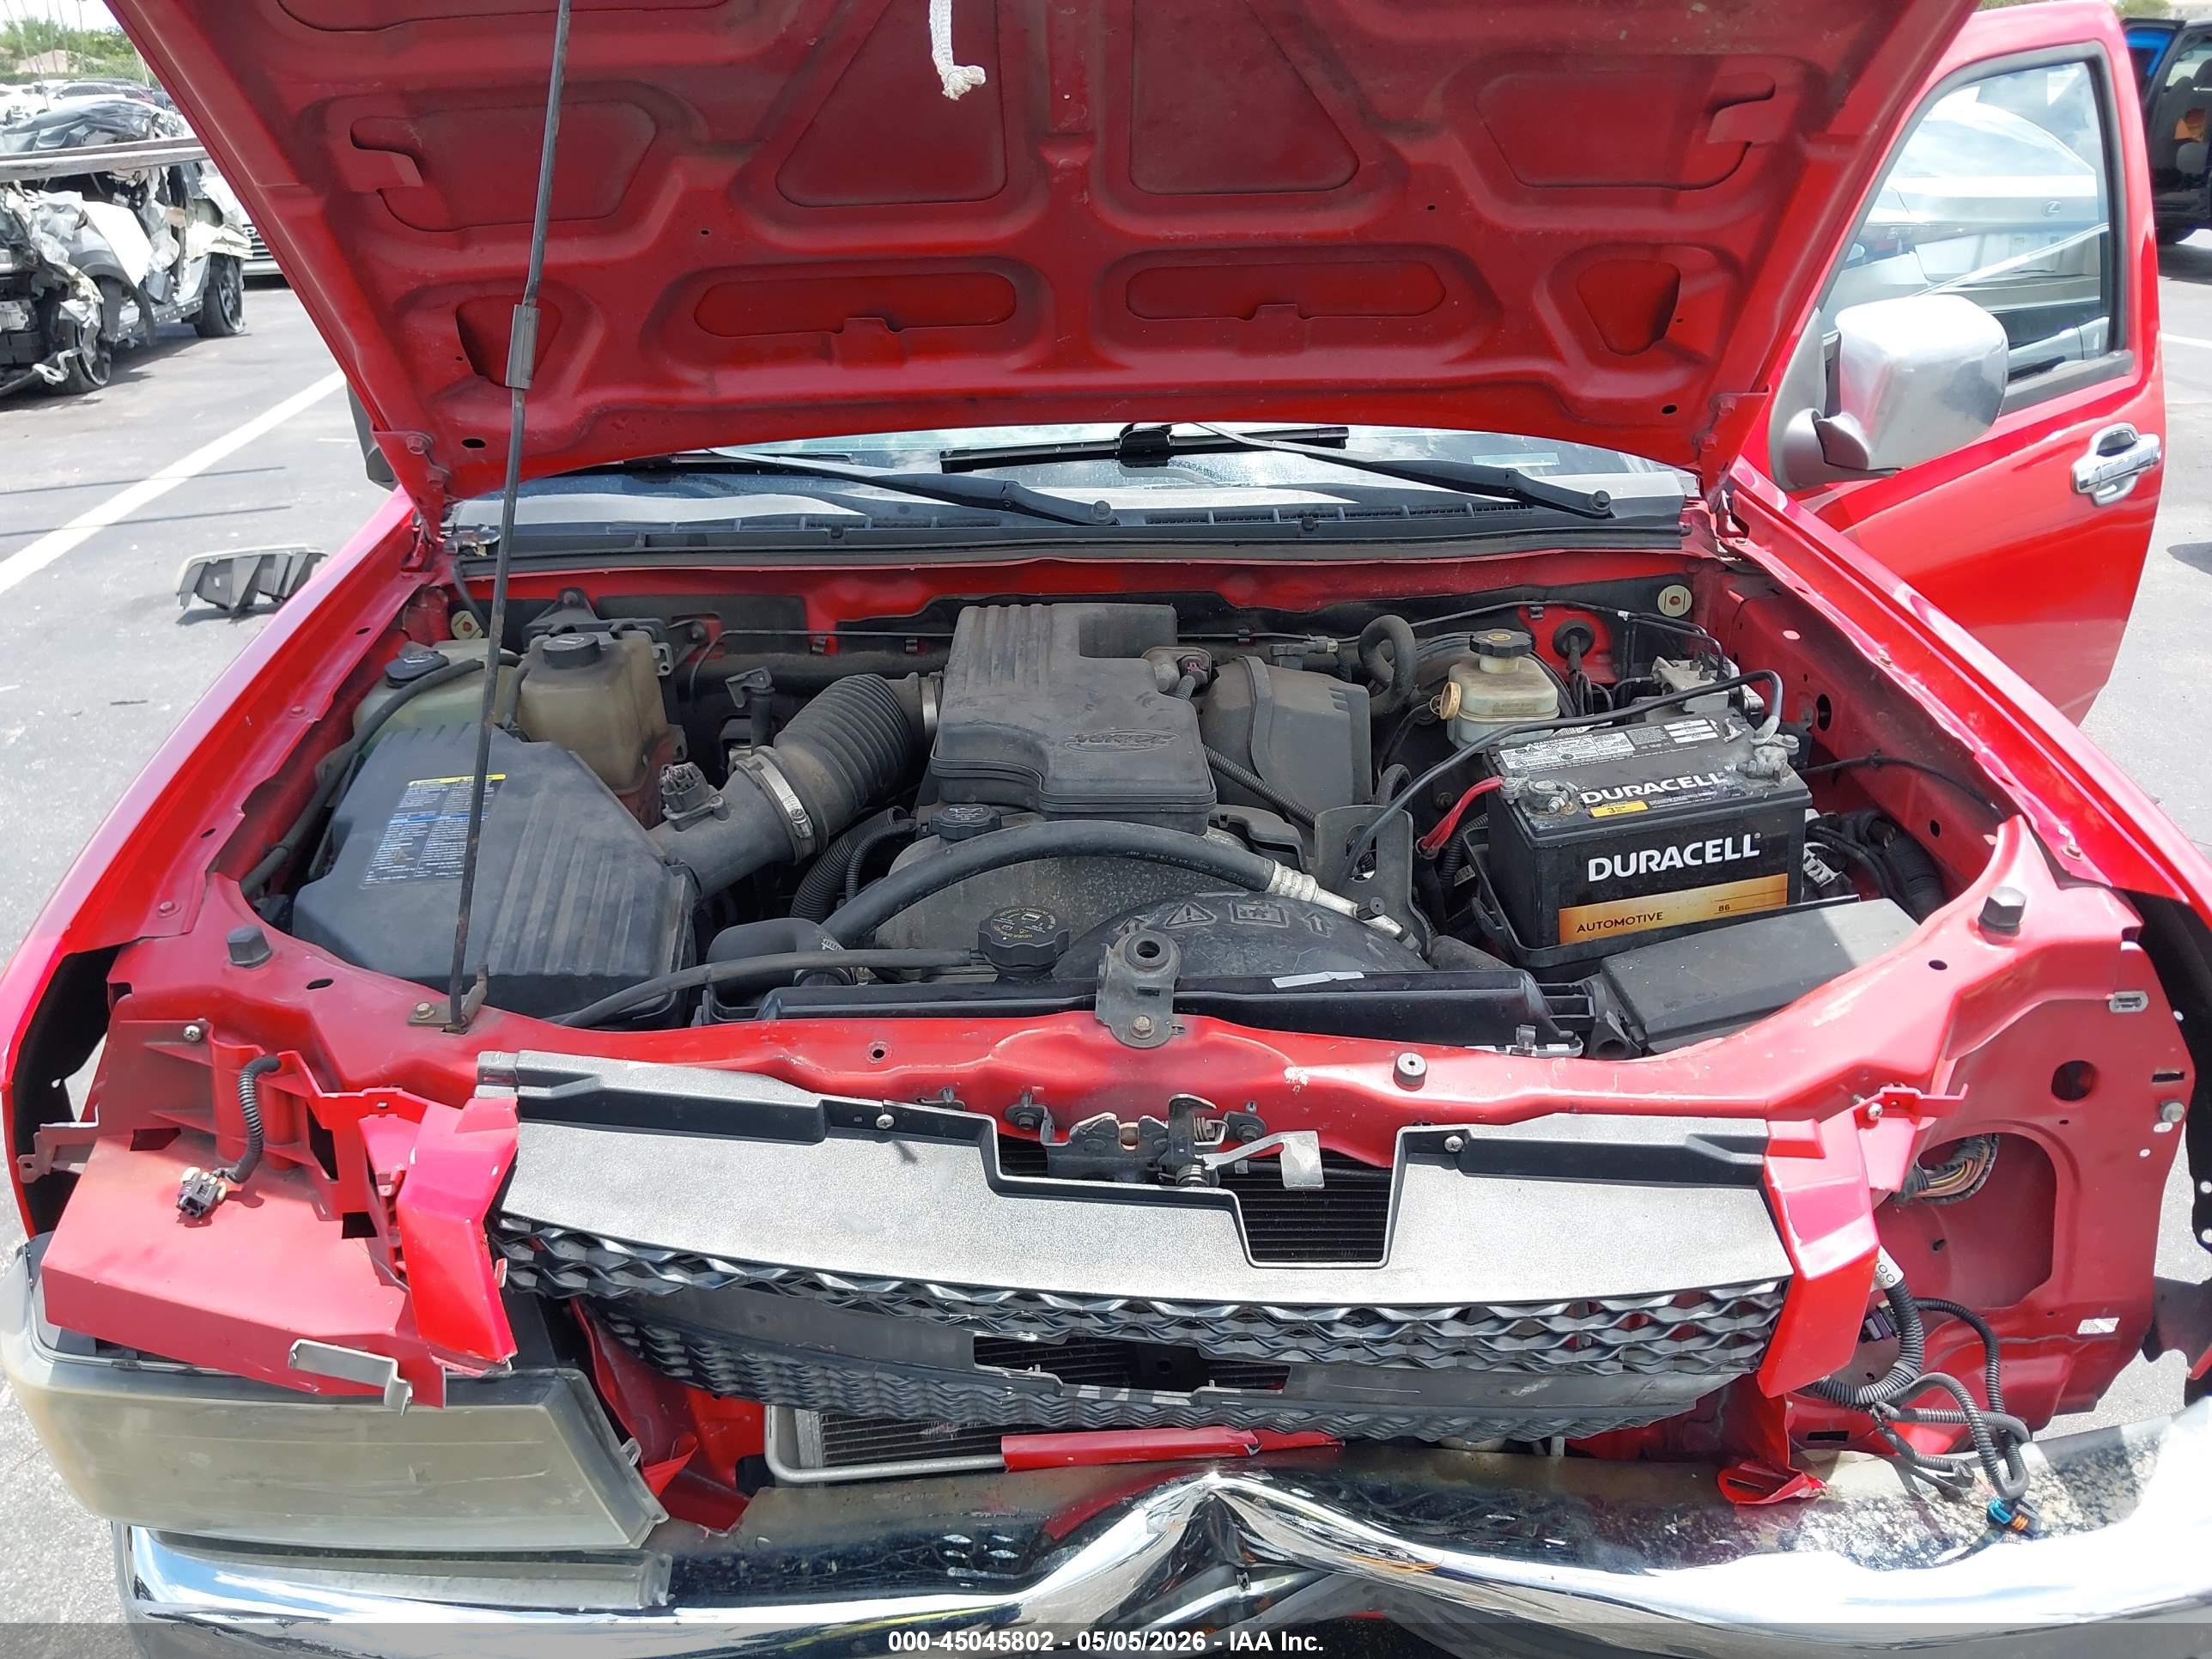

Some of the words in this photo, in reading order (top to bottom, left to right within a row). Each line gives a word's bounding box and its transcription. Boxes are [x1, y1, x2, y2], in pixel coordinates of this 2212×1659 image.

[1579, 773, 1725, 804] DURACELL
[1587, 833, 1760, 882] DURACELL
[1717, 903, 1731, 912] 86
[1576, 911, 1663, 933] AUTOMOTIVE
